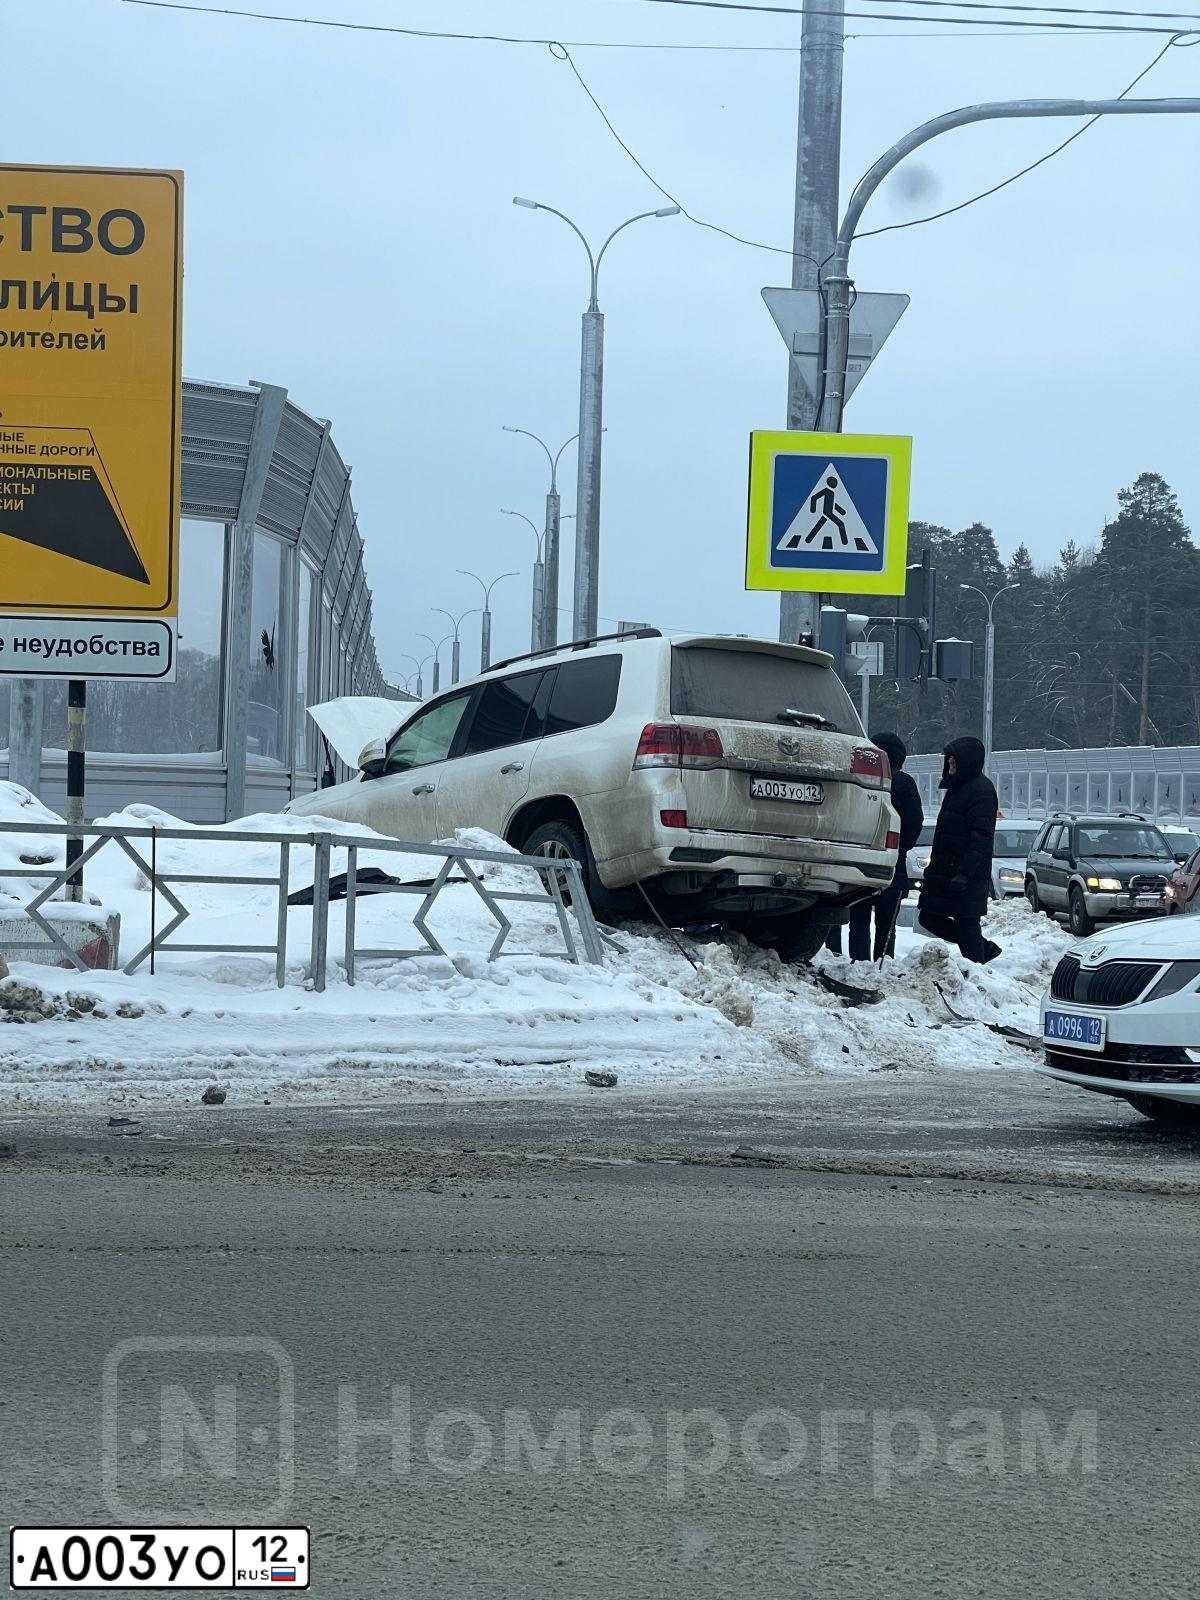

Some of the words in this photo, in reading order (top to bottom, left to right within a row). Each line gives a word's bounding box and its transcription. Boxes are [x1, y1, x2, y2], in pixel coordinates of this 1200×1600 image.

[0, 204, 146, 256] ТВО
[0, 431, 24, 442] ЫЕ
[39, 445, 95, 457] ДОРОГИ
[0, 482, 35, 495] КТЫ
[0, 498, 24, 511] ИИ
[13, 634, 161, 659] неудобства
[806, 785, 817, 797] 12
[1090, 1019, 1100, 1036] 12
